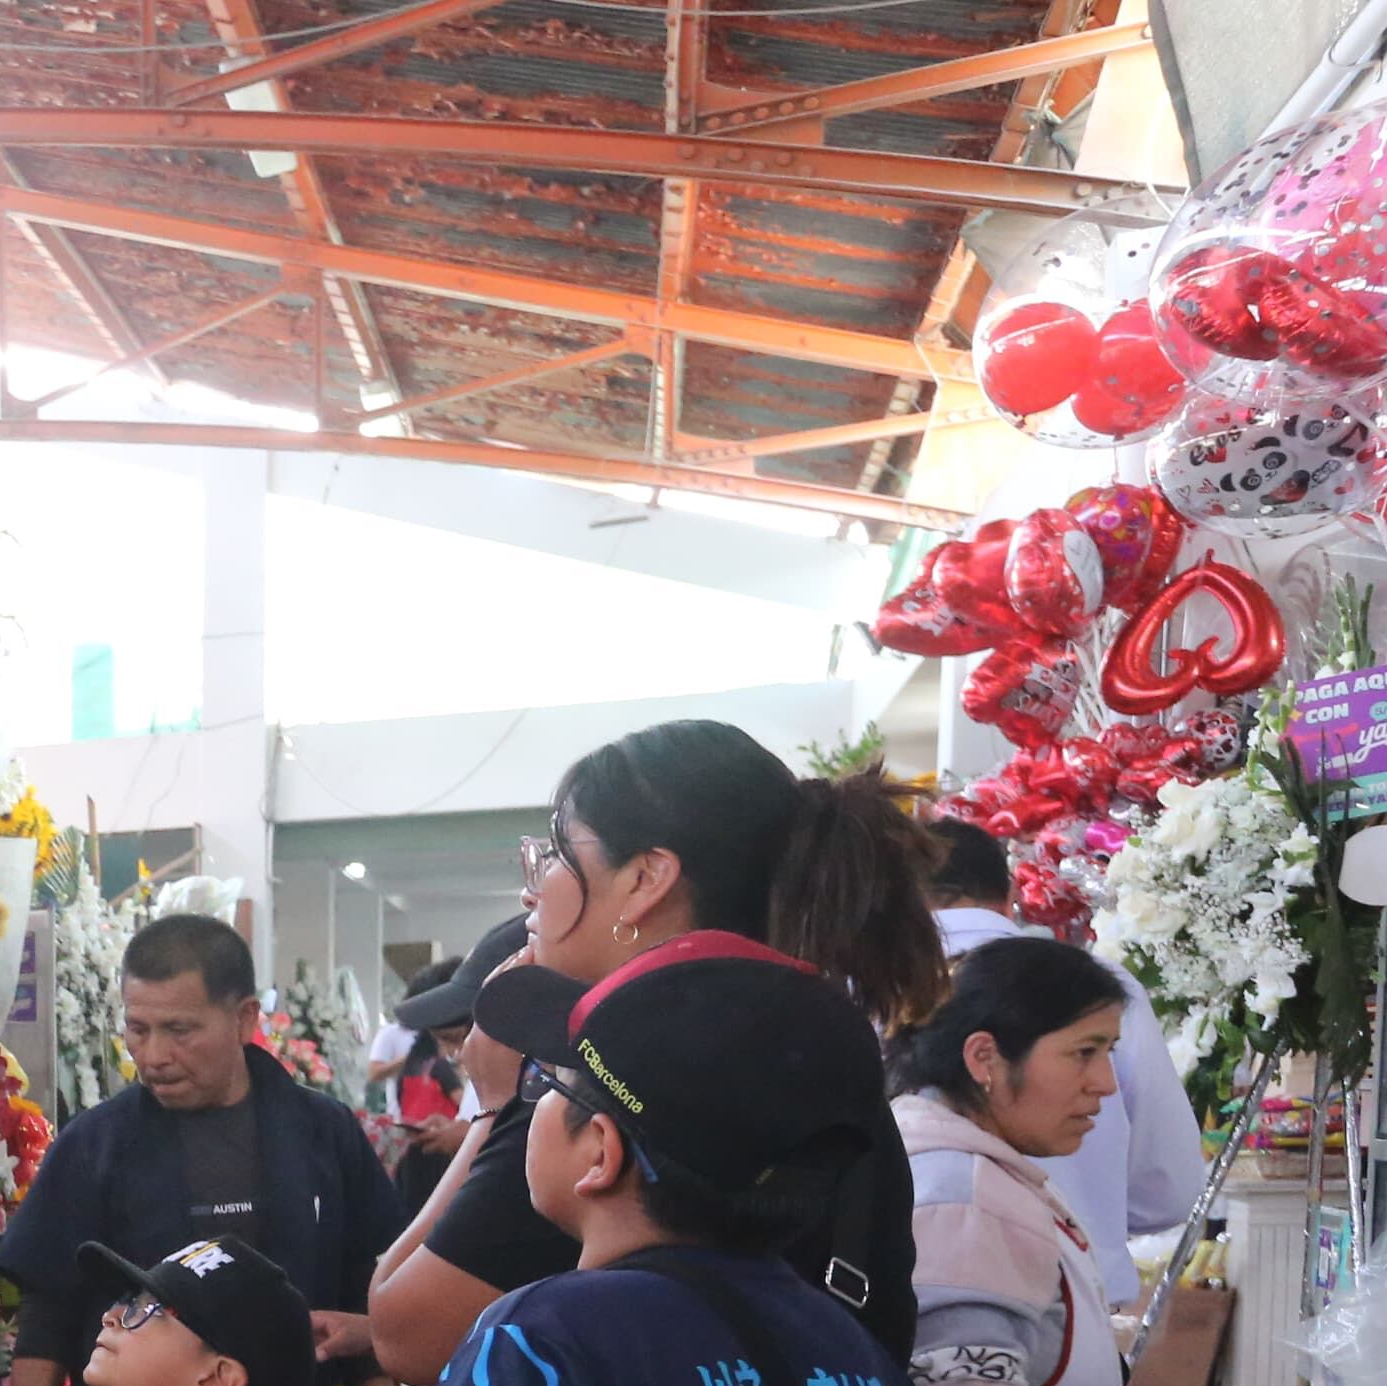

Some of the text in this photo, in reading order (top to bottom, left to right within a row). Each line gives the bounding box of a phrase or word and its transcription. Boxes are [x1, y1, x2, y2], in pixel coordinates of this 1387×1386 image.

[1294, 672, 1387, 704] PAGA AQ
[1305, 702, 1349, 724] CON
[213, 1201, 253, 1215] AUSTIN
